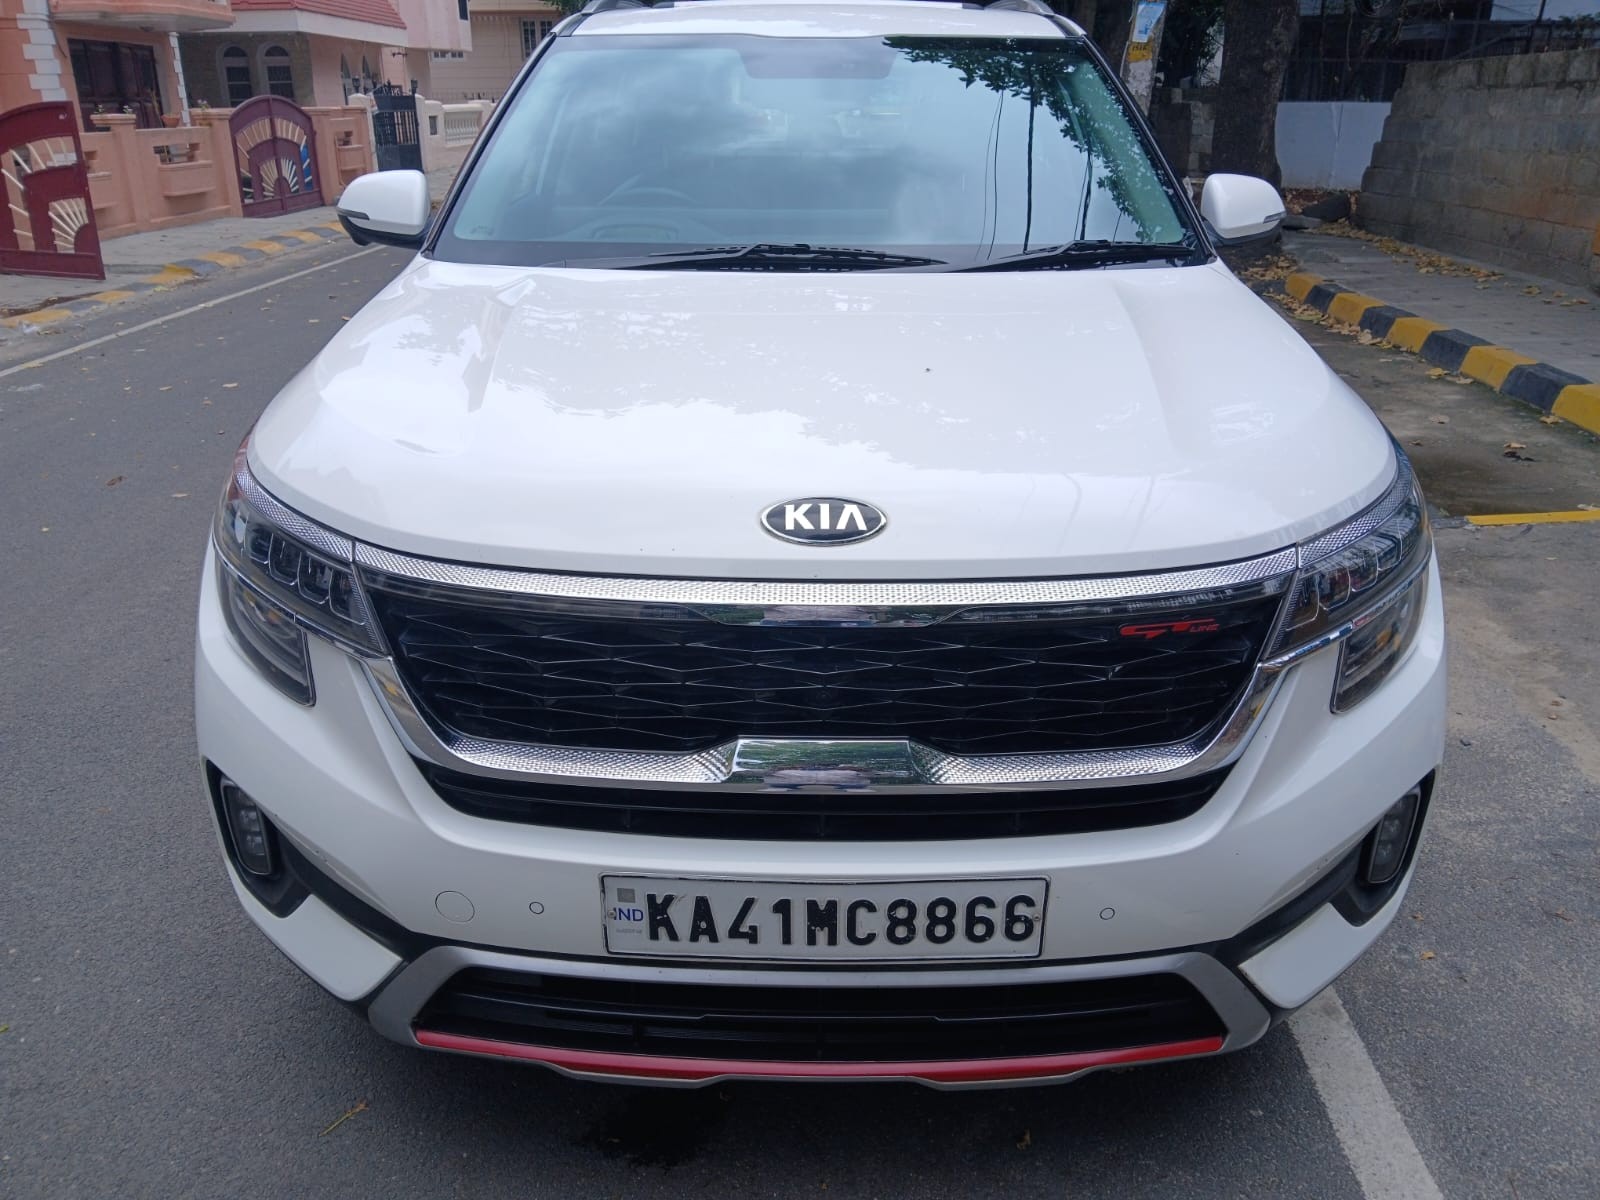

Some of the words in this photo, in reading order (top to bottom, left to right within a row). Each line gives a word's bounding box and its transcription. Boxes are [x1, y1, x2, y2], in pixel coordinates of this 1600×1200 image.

[784, 503, 868, 531] KIA
[612, 907, 644, 922] IND
[646, 893, 1037, 946] KA41MC8866
